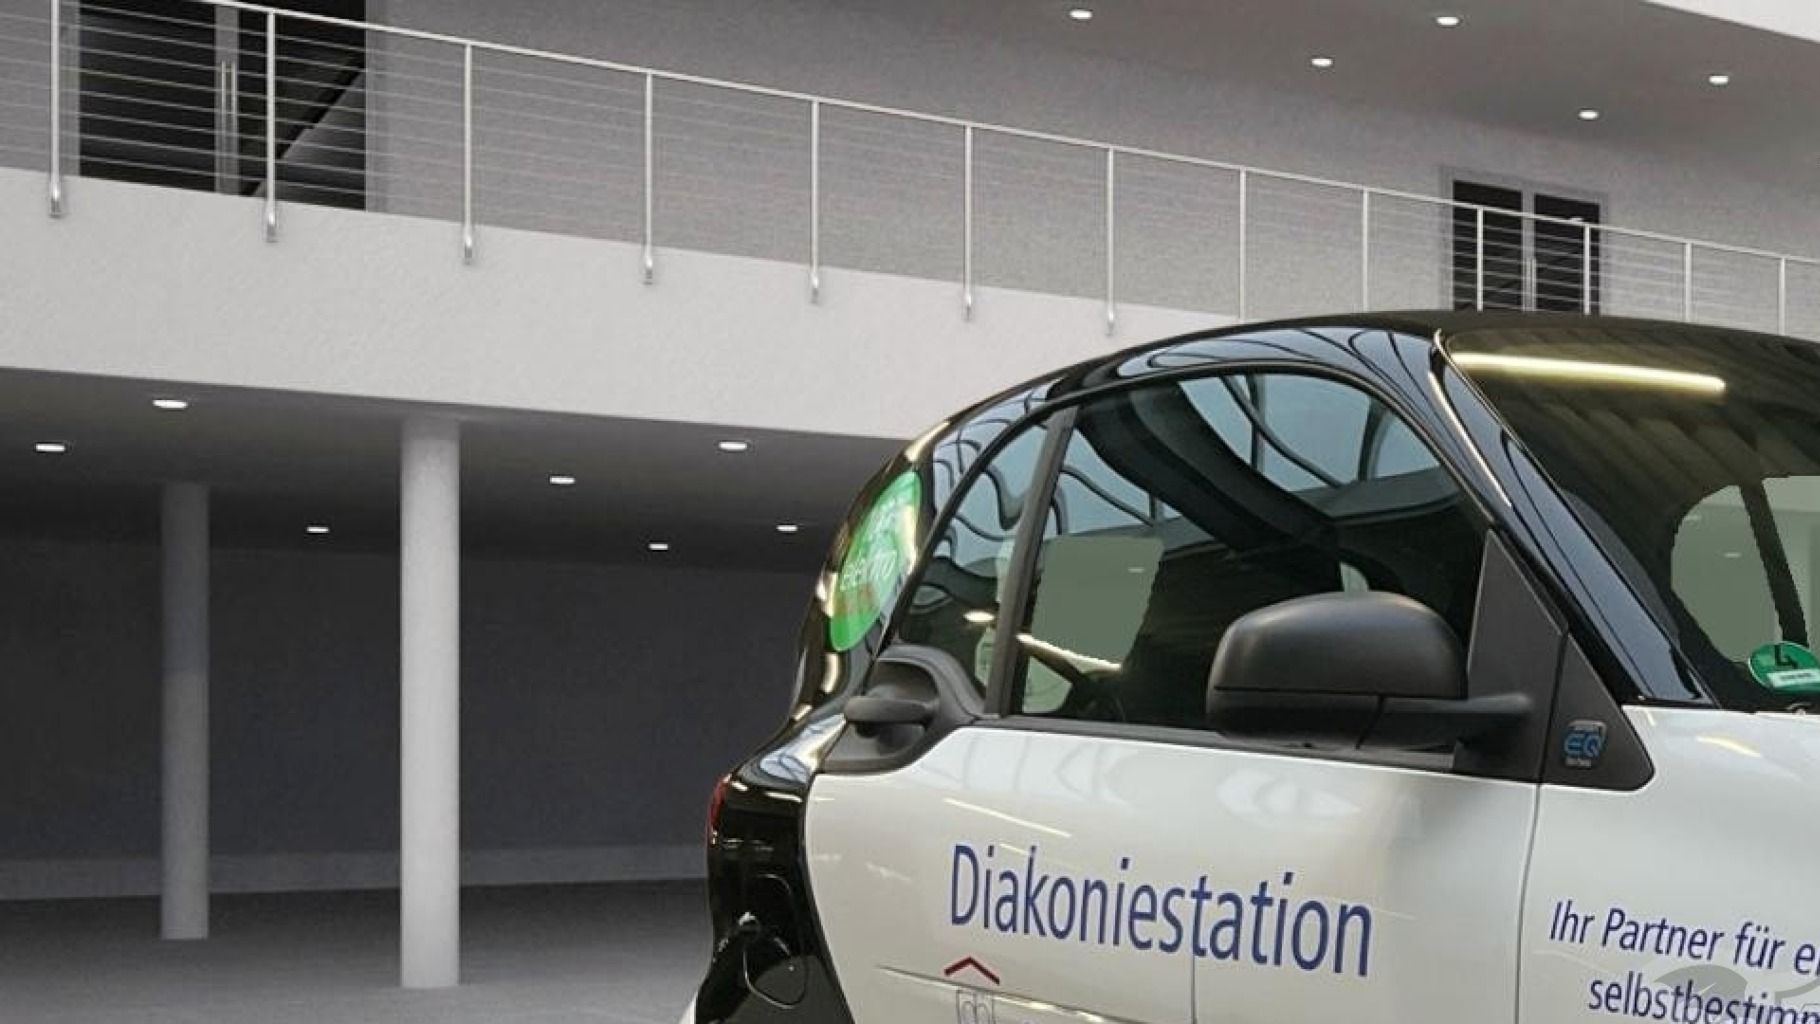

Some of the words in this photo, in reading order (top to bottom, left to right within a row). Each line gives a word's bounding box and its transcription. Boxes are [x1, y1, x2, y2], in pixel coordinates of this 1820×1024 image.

[950, 843, 1372, 977] Diakoniestation
[1550, 899, 1595, 944] Ihr
[1601, 907, 1724, 961] Partner
[1733, 921, 1786, 970] für
